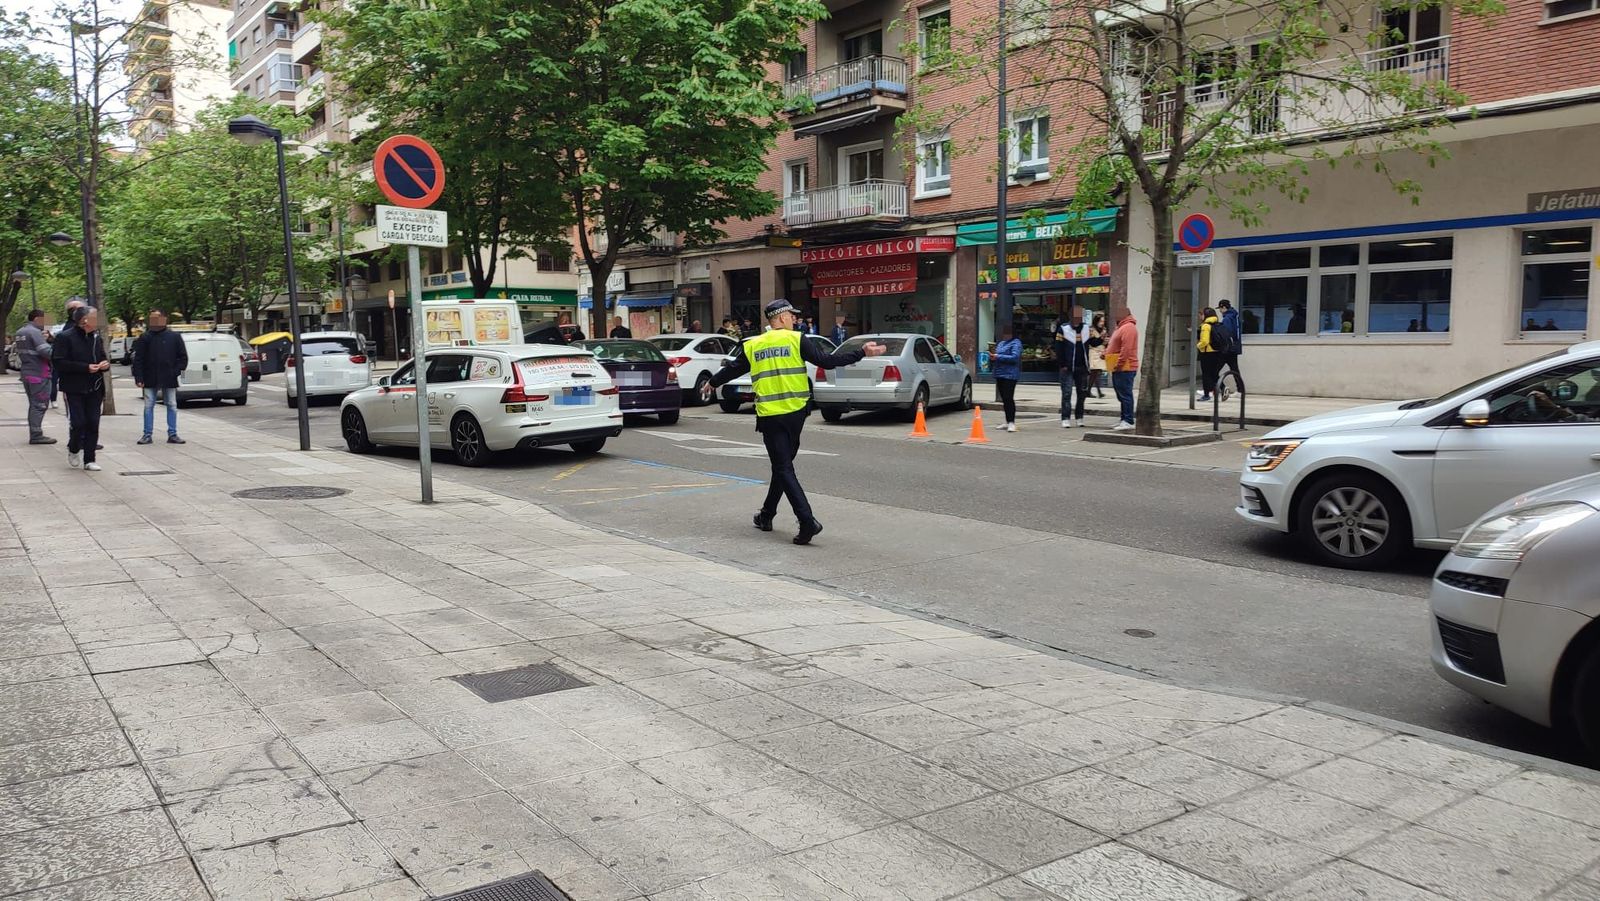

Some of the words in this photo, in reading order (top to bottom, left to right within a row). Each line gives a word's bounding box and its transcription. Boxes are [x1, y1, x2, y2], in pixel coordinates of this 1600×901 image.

[393, 222, 434, 233] EXCEPTO
[381, 231, 405, 240] CARGA
[405, 232, 410, 240] Y
[411, 232, 444, 243] DESCARGA
[802, 239, 915, 262] PSICOTECNICO
[816, 267, 865, 279] CONDUCTORES
[869, 262, 912, 274] CAZADORES
[823, 285, 864, 297] CENTRO
[869, 282, 904, 294] DUERO
[529, 294, 554, 302] RURAL
[754, 347, 791, 362] POLICIA
